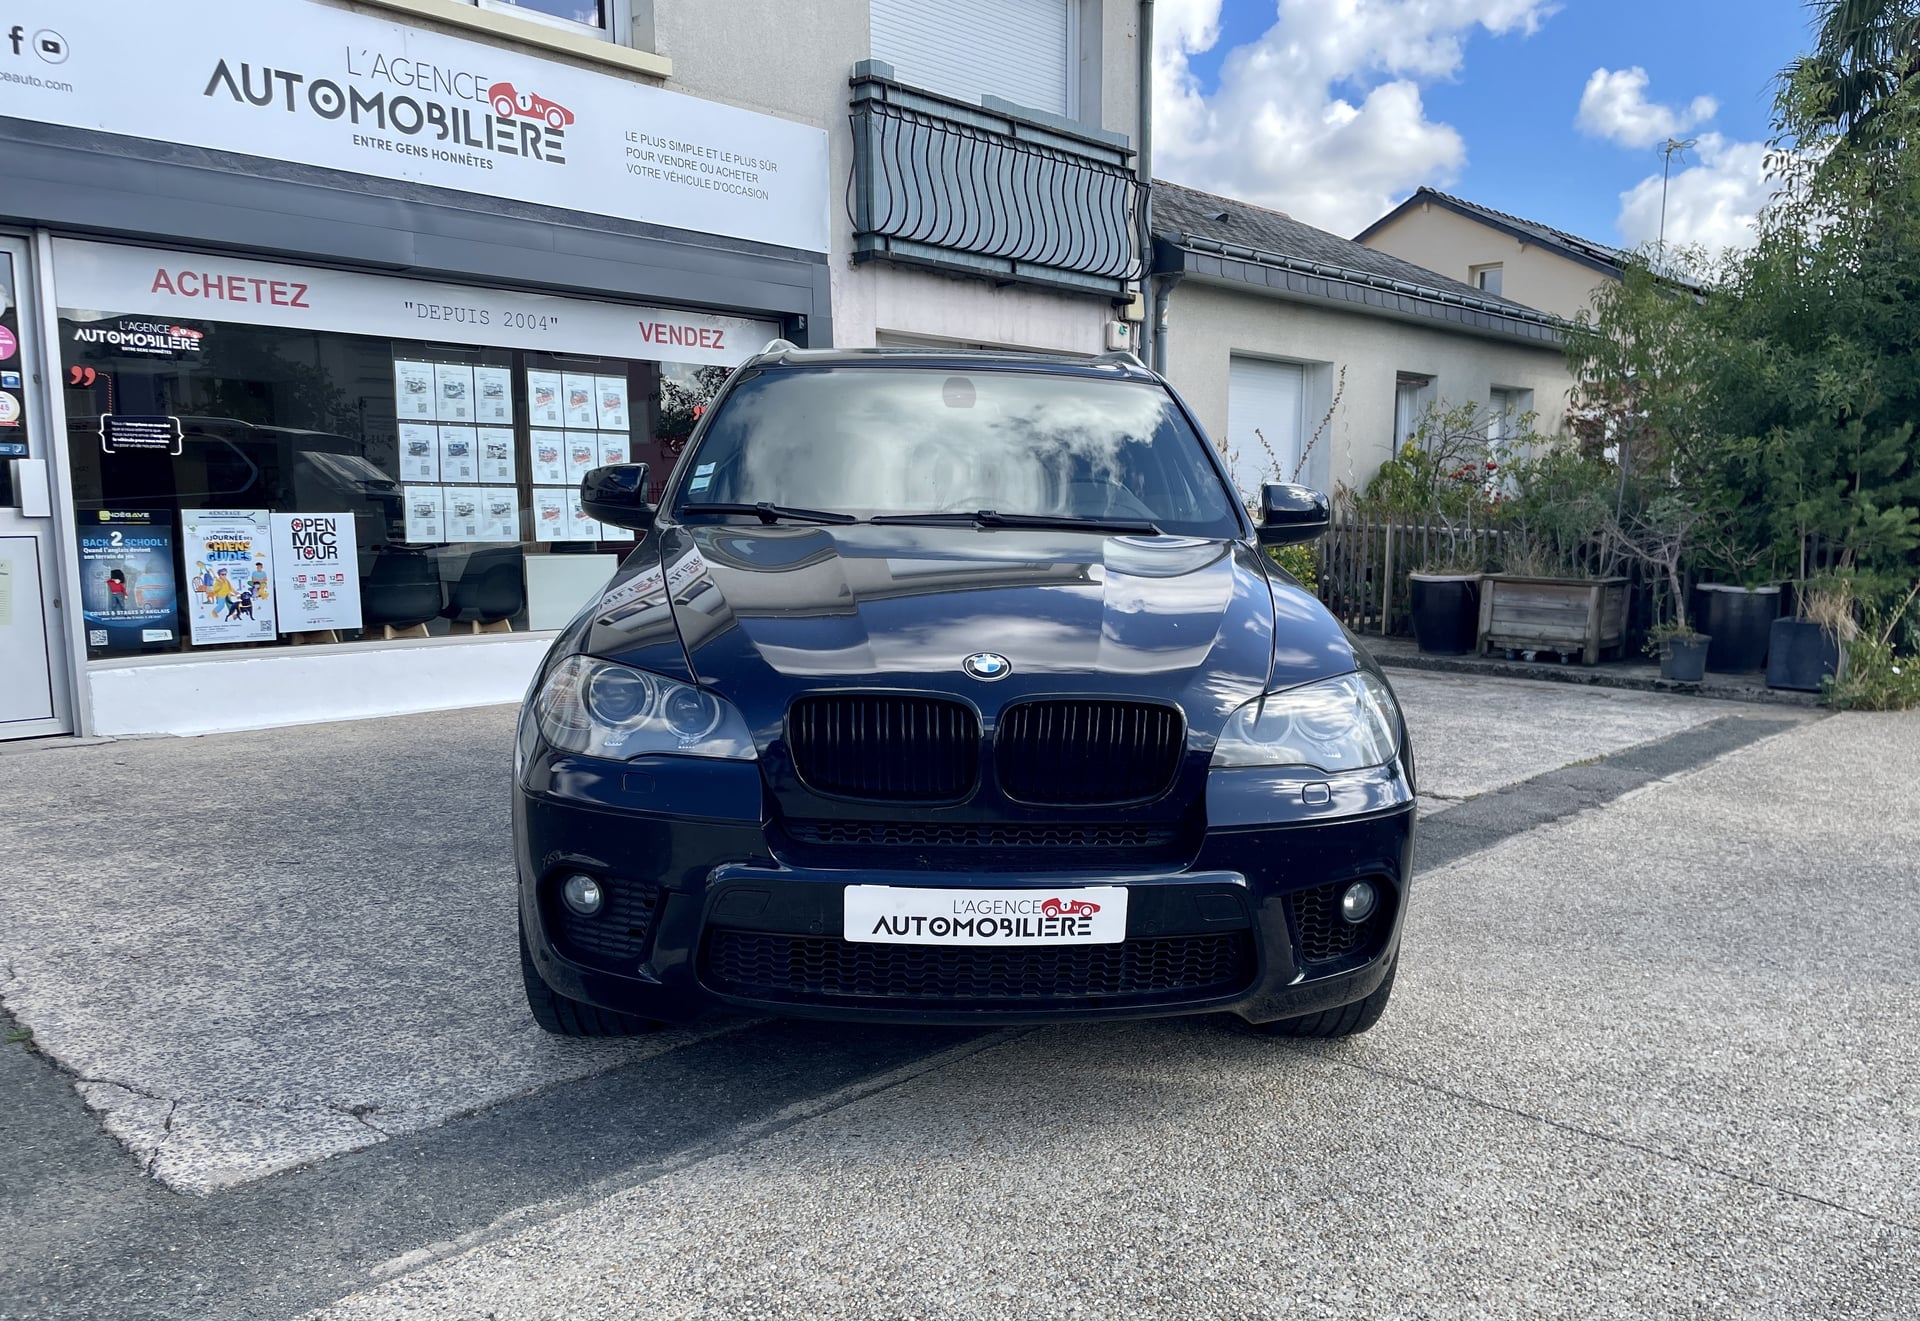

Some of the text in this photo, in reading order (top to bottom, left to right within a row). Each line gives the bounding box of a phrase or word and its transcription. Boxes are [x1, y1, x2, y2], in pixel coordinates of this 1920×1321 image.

[352, 134, 494, 170] ENTRE GENS HONNÊTES
[625, 131, 778, 173] LE PLUS SIMPLE ET LE PLUS SÛR
[626, 147, 759, 183] POUR VENDRE OU ACHETER
[626, 163, 769, 201] VOTRE VÉHICULE D'OCCASION
[151, 268, 310, 309] ACHETEZ
[638, 321, 726, 350] VENDEZ
[291, 518, 337, 533] OPEN
[82, 538, 109, 547] BACK
[110, 531, 123, 547] 2
[125, 538, 163, 547] SCHOOL
[205, 541, 251, 552] CHIENS
[292, 531, 337, 546] MIC
[207, 551, 252, 562] GUIDES
[292, 545, 338, 560] TOUR
